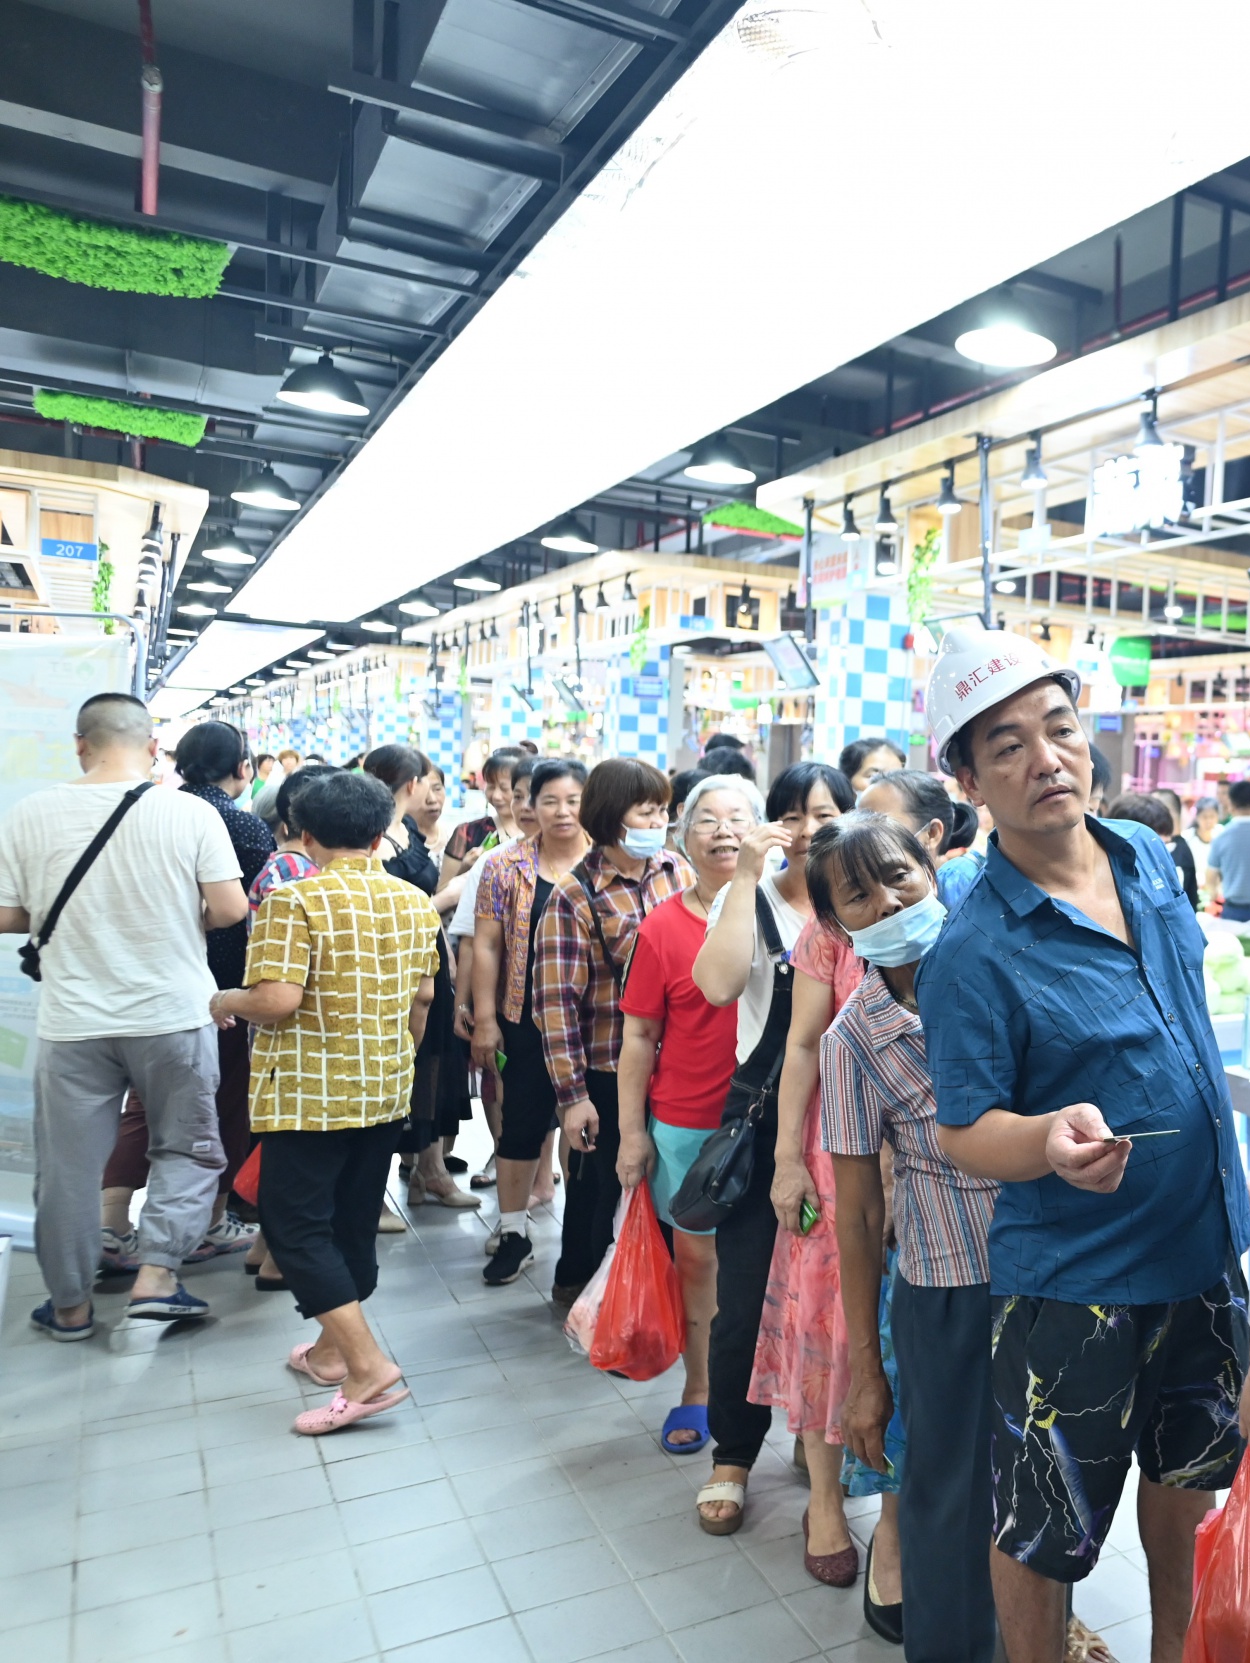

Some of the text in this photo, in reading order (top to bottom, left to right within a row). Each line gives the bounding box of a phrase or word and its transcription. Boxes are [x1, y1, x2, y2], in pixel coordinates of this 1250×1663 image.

[56, 544, 83, 557] 207
[955, 652, 1022, 701] 鼎汇建设
